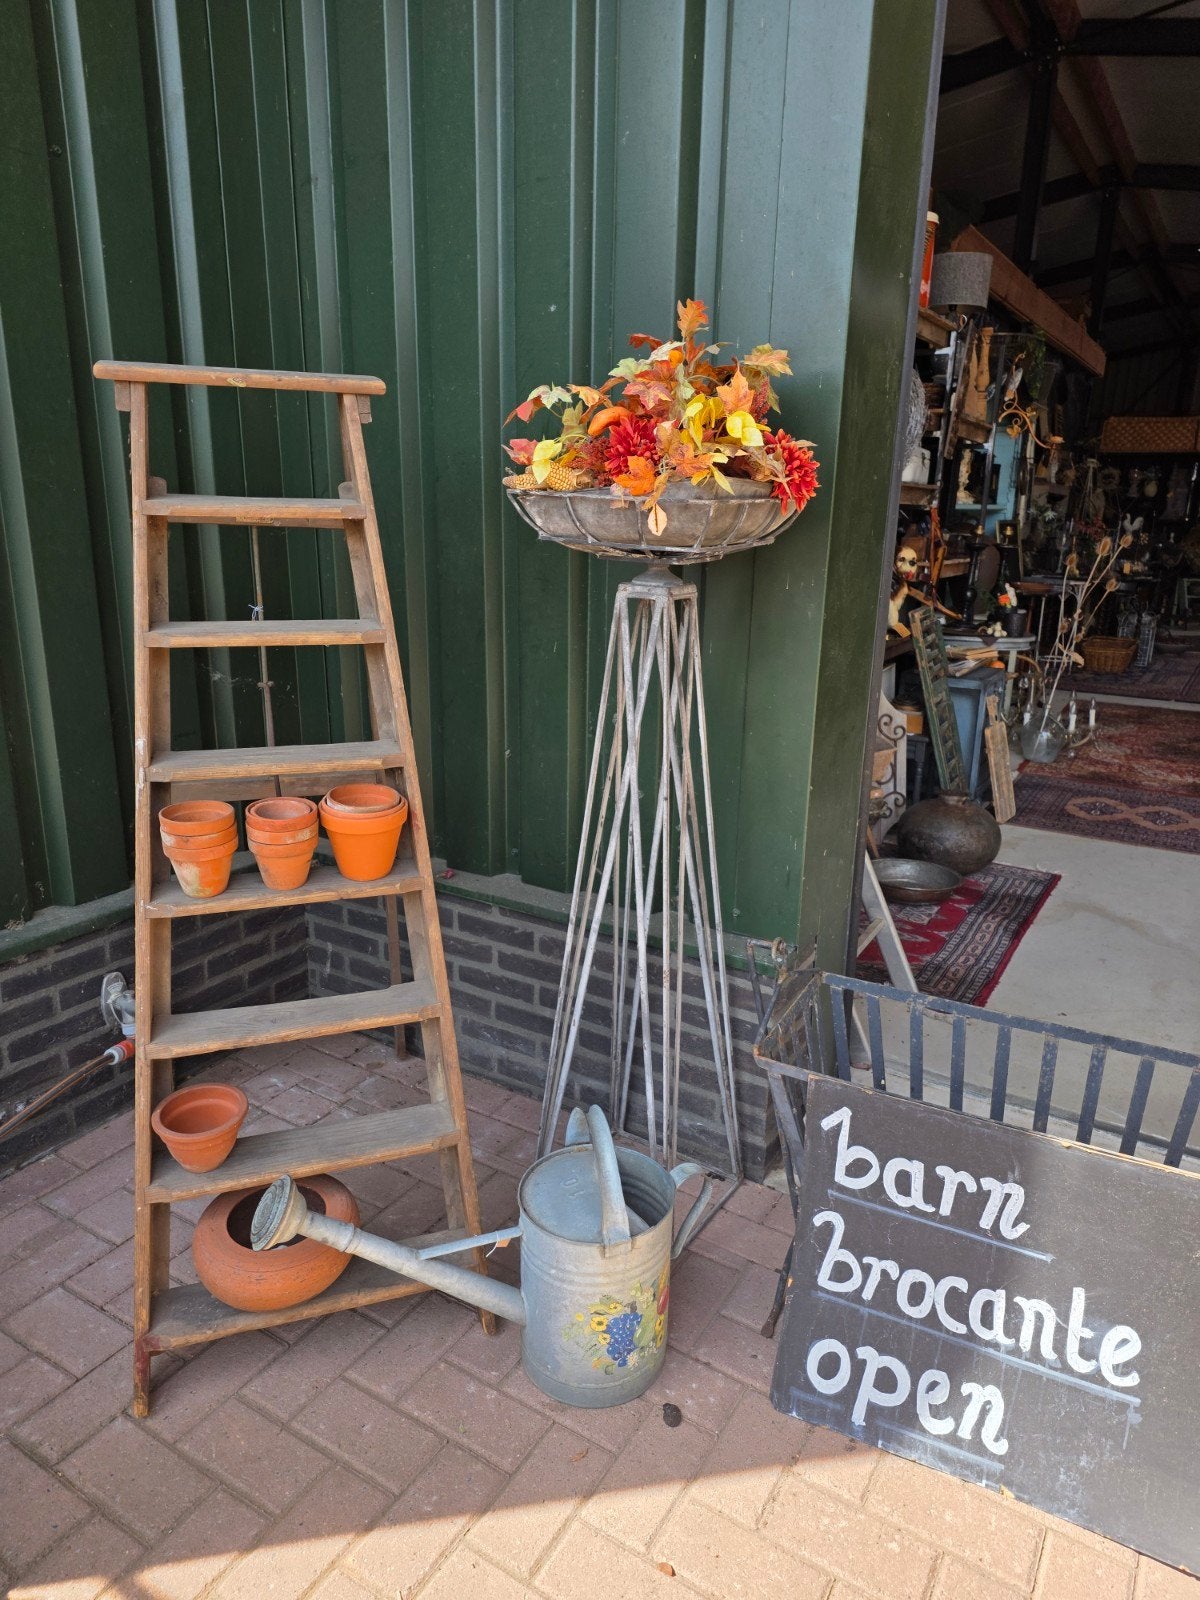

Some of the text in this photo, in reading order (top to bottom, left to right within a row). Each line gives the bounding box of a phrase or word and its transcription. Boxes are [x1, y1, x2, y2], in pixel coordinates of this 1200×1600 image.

[820, 1106, 1031, 1240] barn
[812, 1210, 1142, 1388] brocante
[806, 1338, 1009, 1456] open
